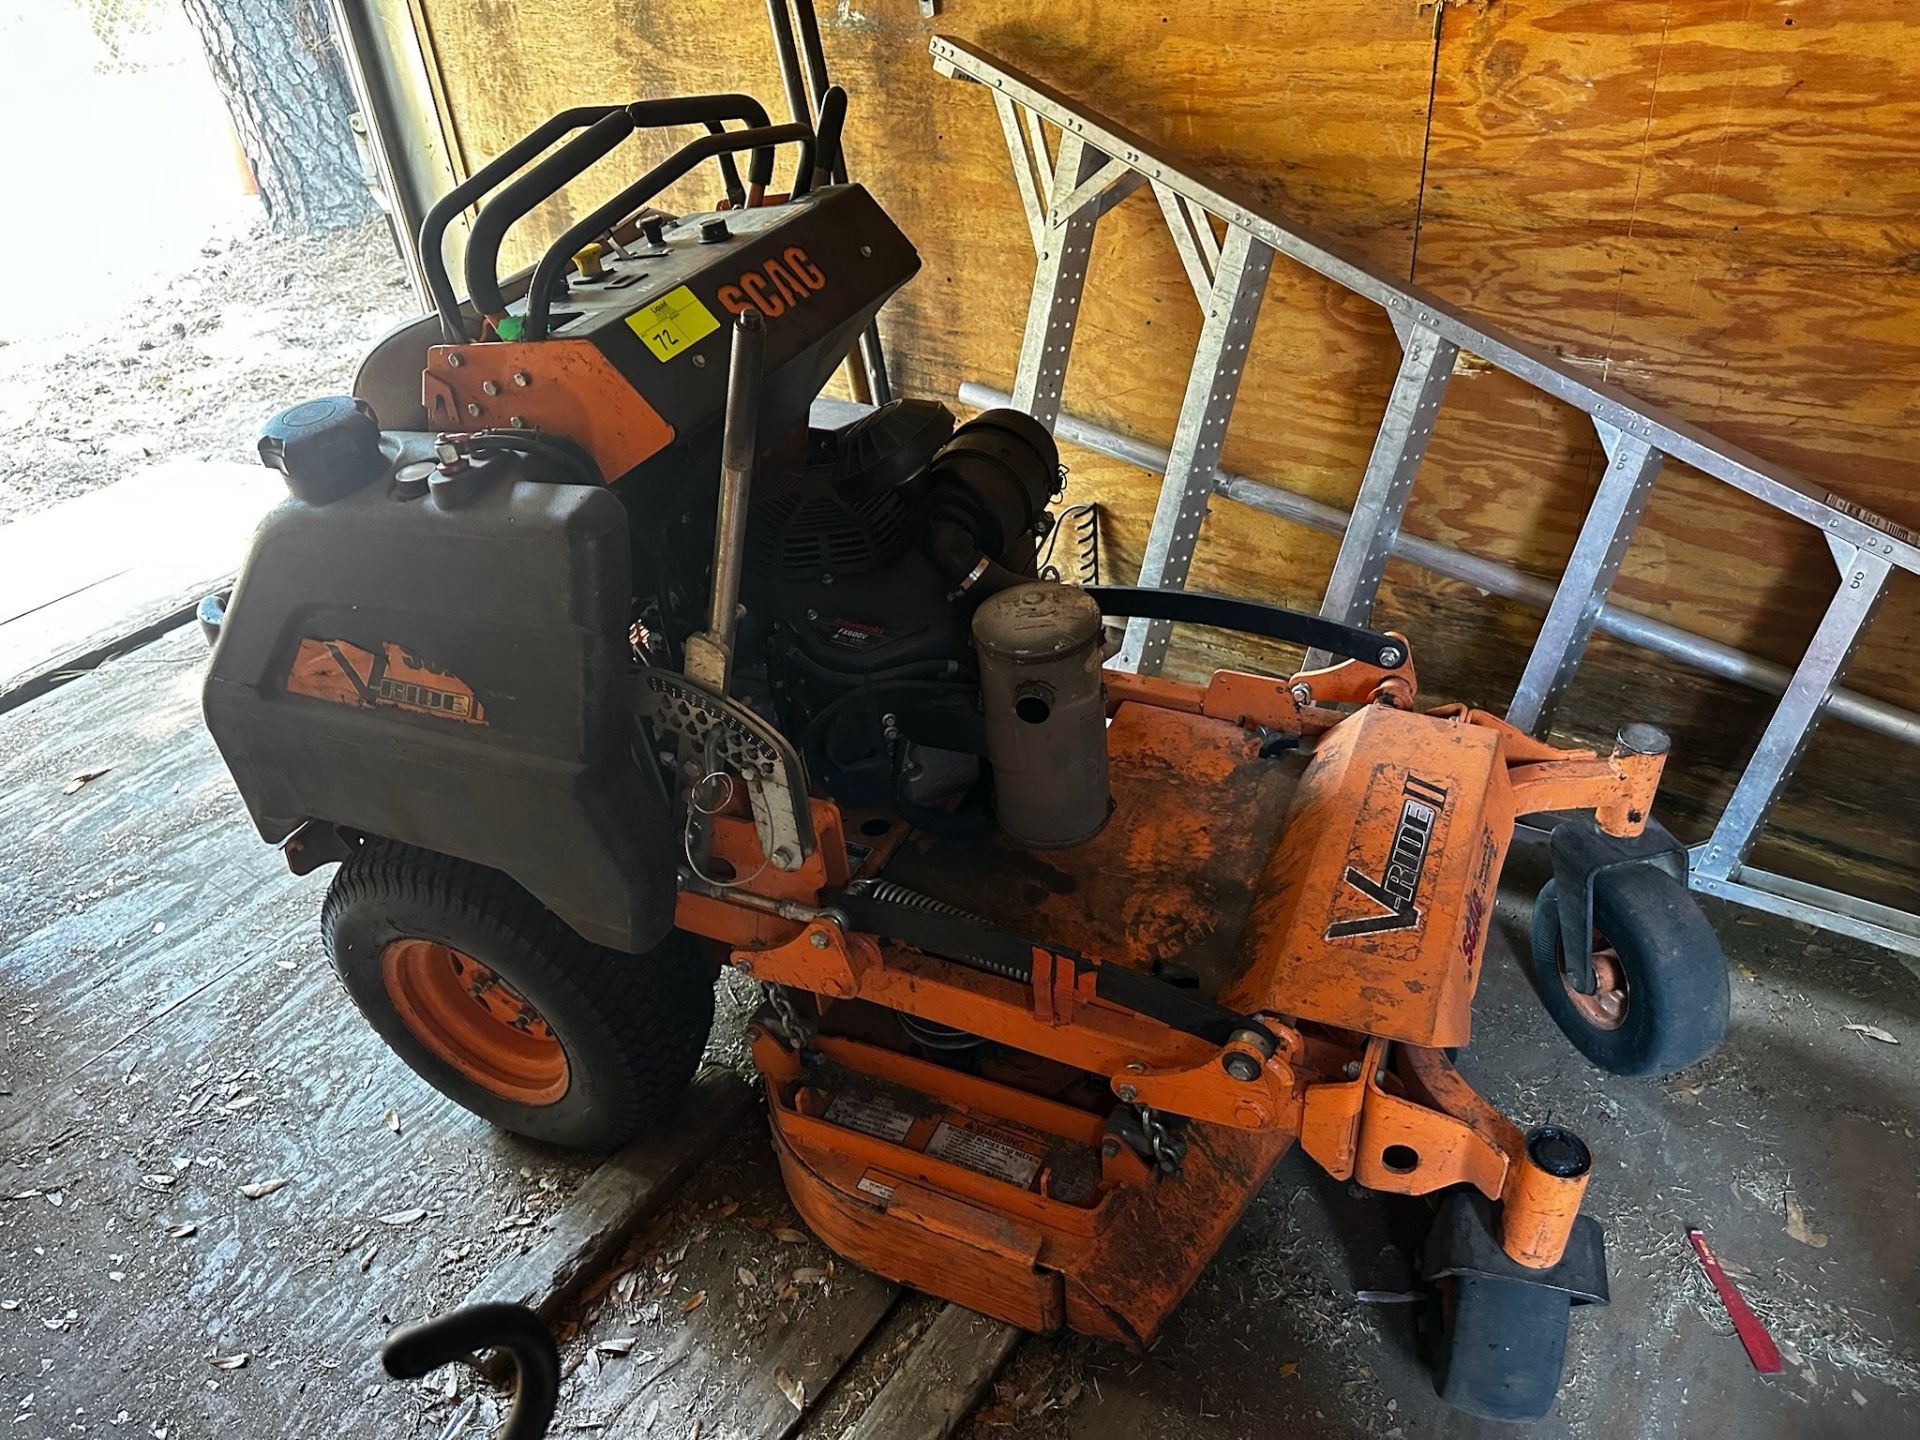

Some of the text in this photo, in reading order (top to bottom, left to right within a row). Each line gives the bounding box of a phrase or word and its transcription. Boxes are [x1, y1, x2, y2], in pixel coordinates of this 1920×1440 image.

[716, 245, 826, 317] SCAG
[653, 329, 679, 351] 72
[1325, 799, 1436, 942] V-RIDE
[975, 1122, 1026, 1149] WARNING
[976, 1136, 1000, 1148] BLADES
[1000, 1145, 1013, 1154] AND
[1014, 1150, 1033, 1161] BELTS
